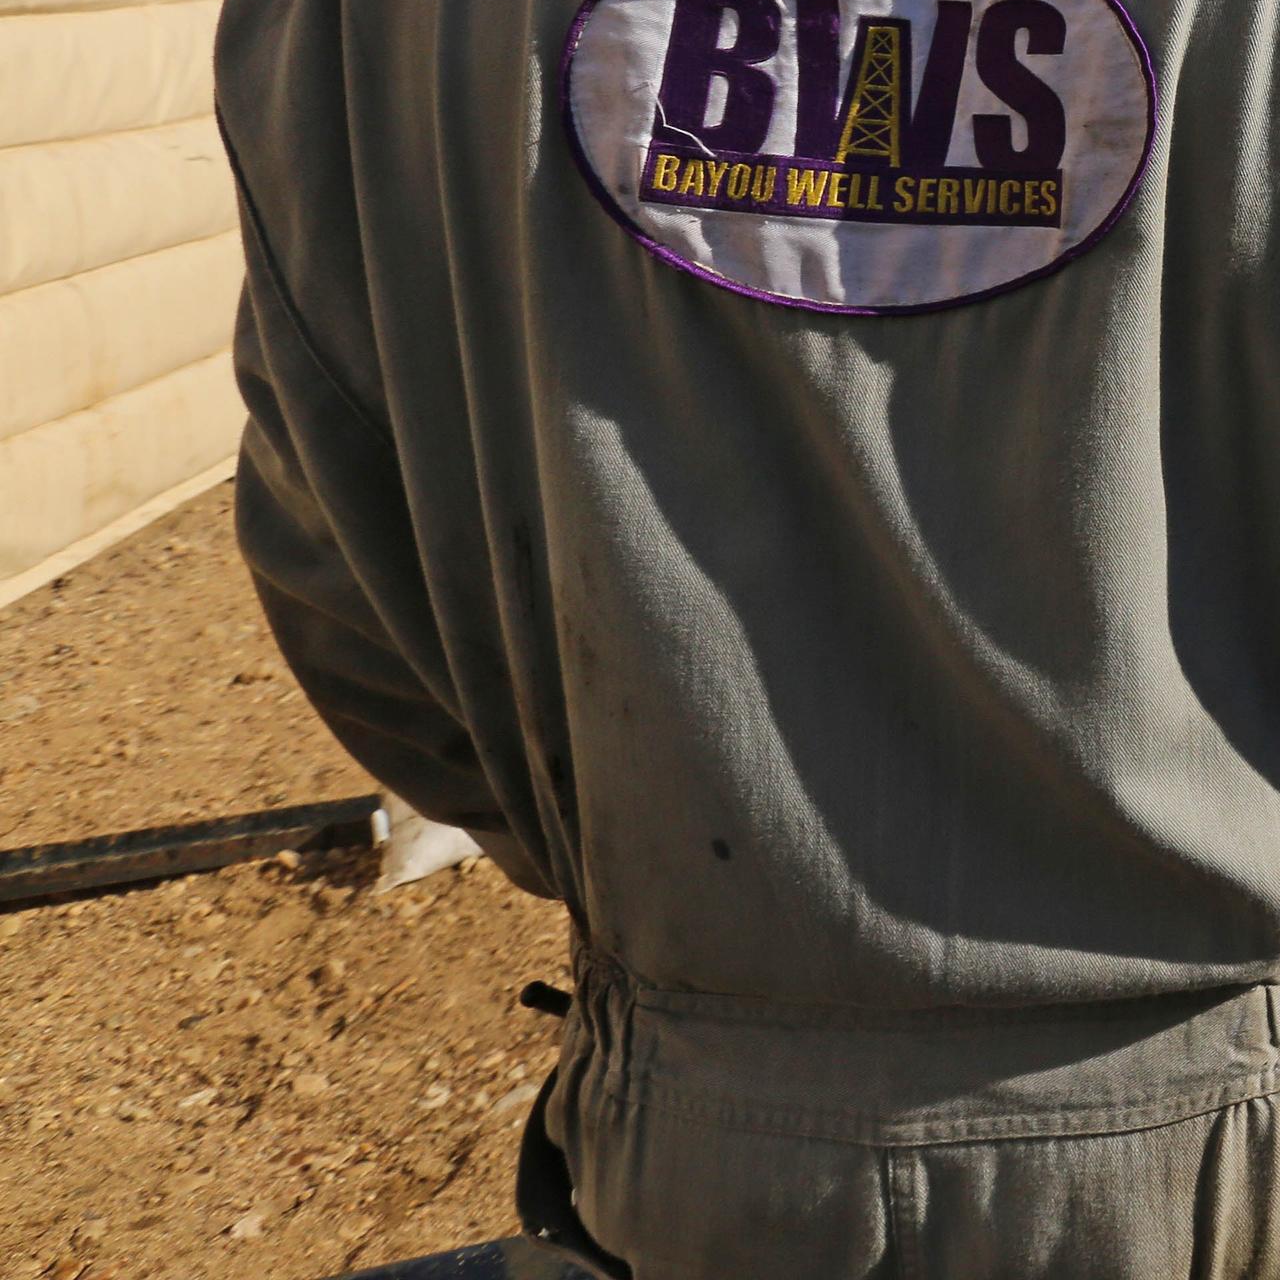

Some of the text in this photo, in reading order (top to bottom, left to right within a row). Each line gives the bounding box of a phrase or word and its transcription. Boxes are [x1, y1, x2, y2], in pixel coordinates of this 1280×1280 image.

[652, 154, 1058, 216] BAYOU WELL SERVICES
